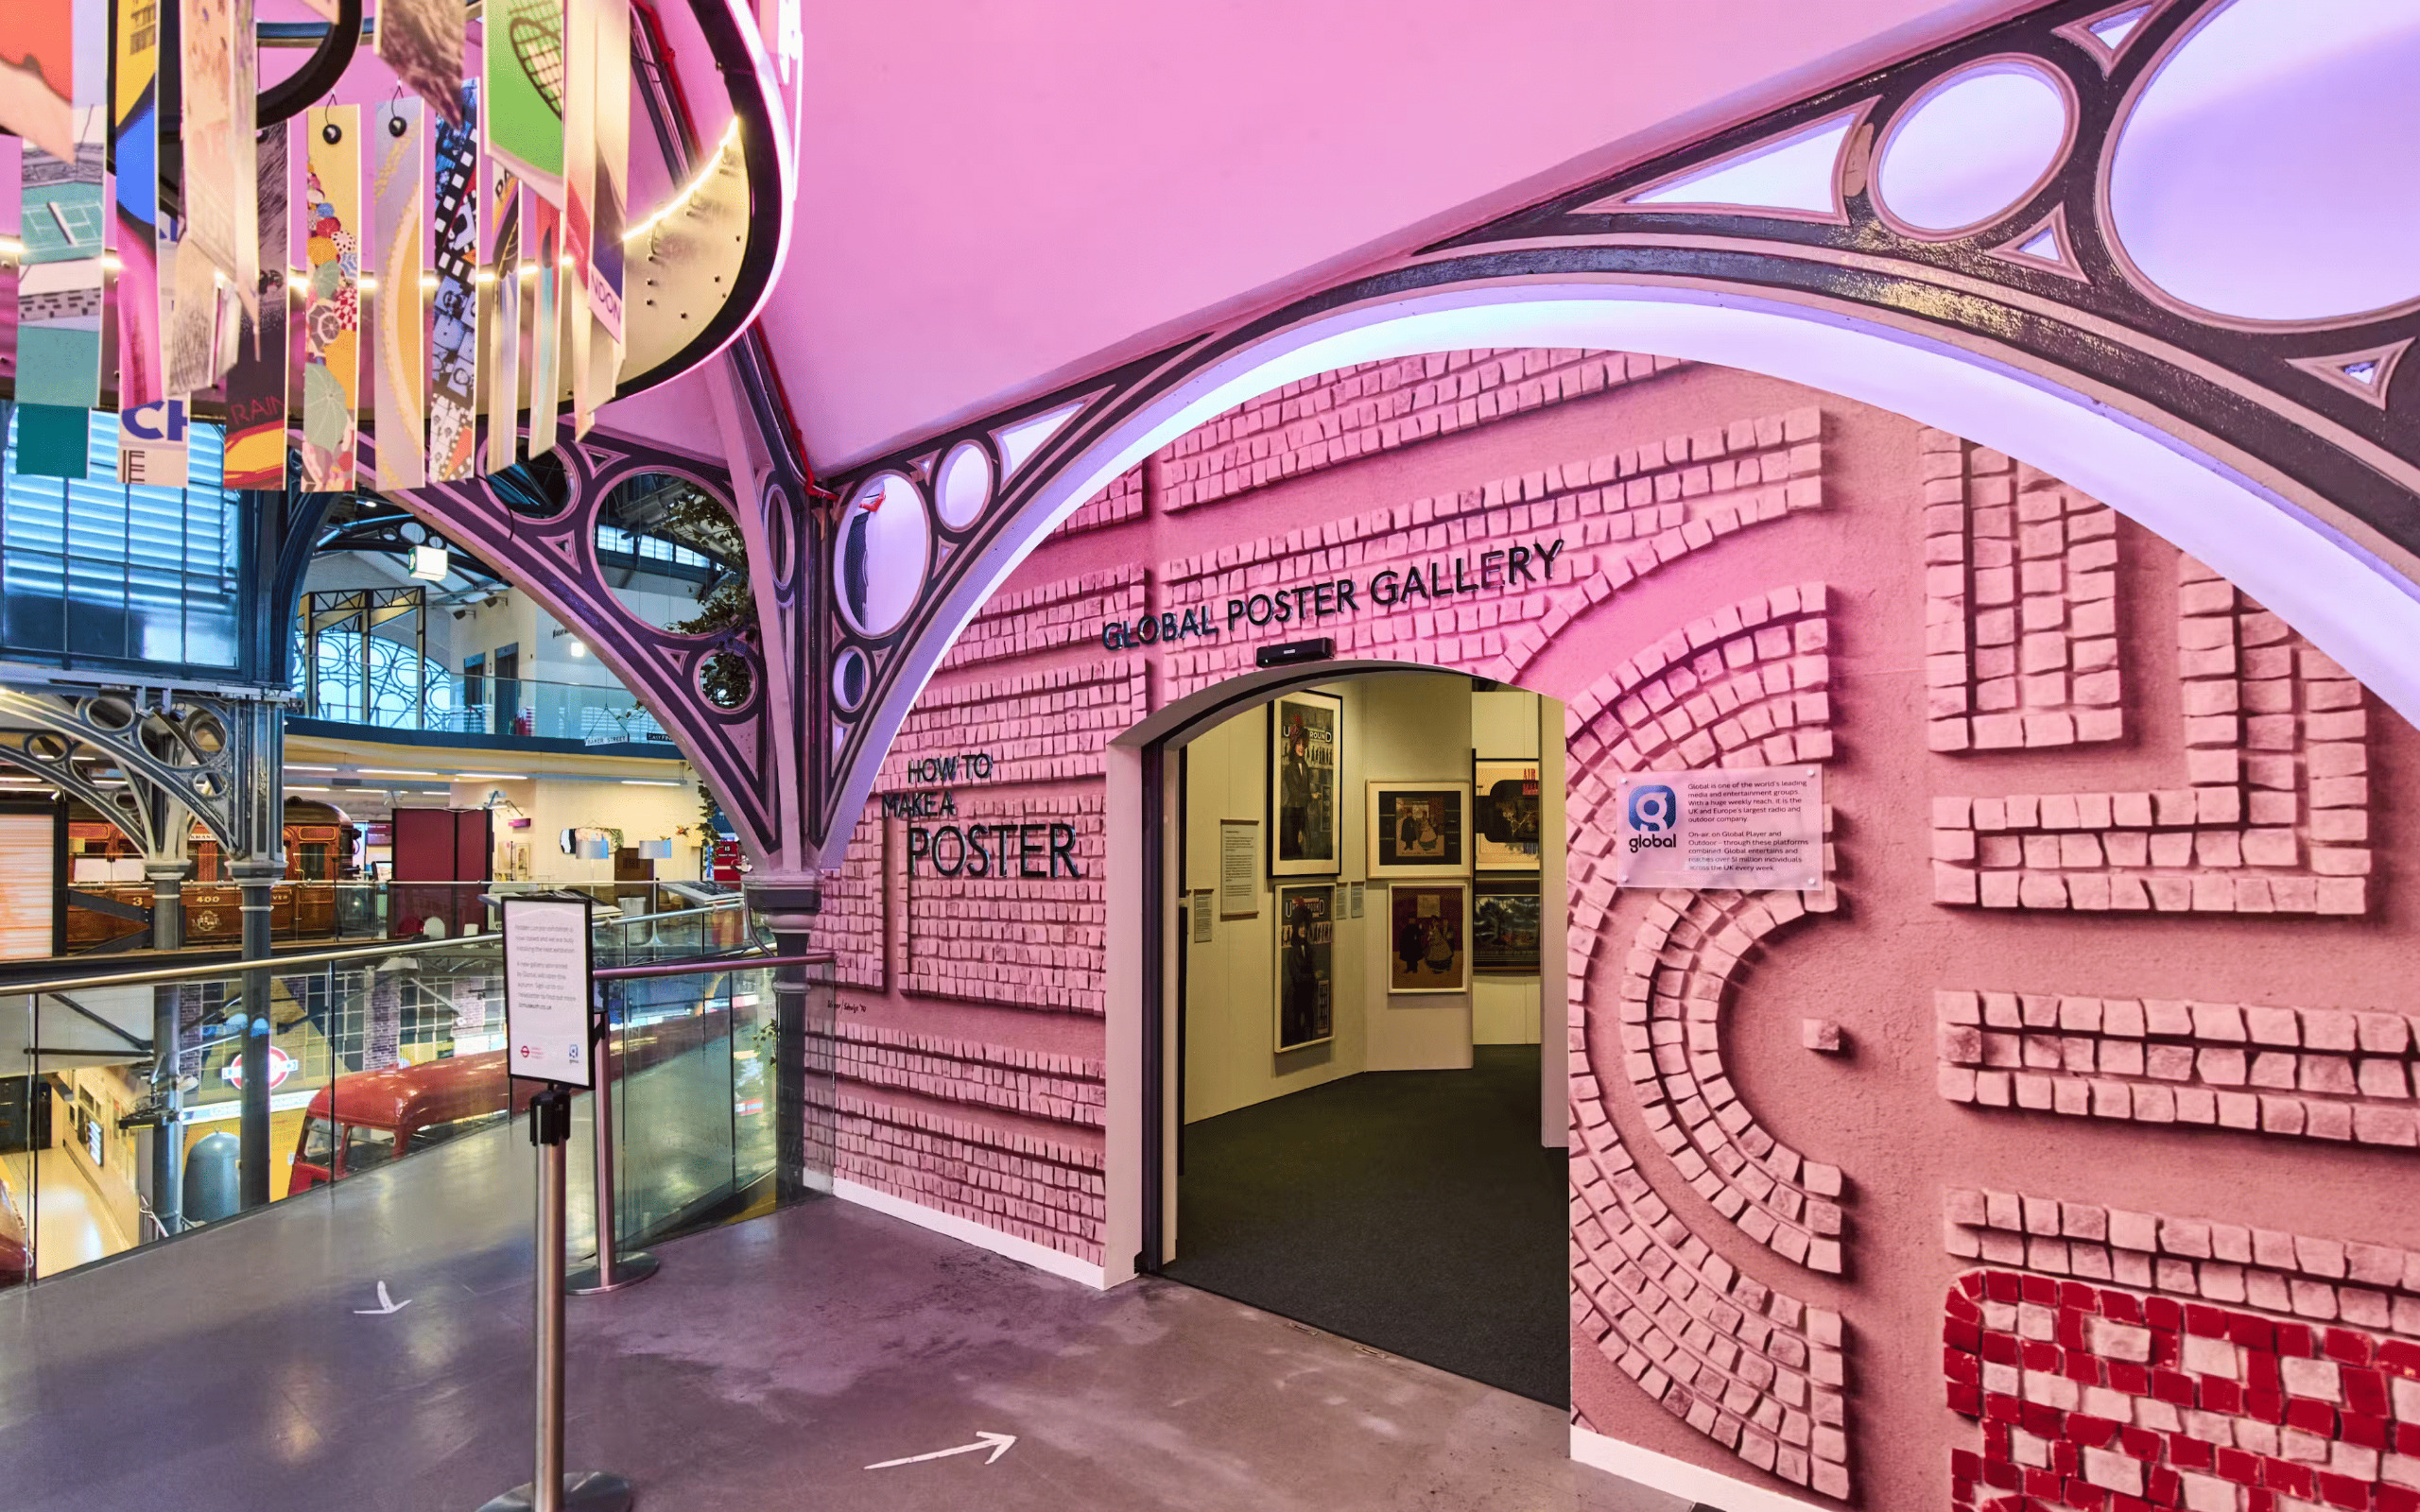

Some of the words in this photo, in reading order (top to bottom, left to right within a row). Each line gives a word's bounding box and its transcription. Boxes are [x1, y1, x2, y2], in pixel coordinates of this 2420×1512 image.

[1102, 605, 1219, 650] GLOBAL
[1228, 578, 1361, 631] POSTER
[1371, 538, 1565, 606] GALLERY
[908, 756, 959, 783] HOW
[961, 753, 993, 780] TO
[882, 792, 938, 817] MAKE
[942, 792, 956, 816] A
[909, 823, 1080, 879] POSTER
[1629, 833, 1676, 853] global
[132, 897, 143, 906] 3
